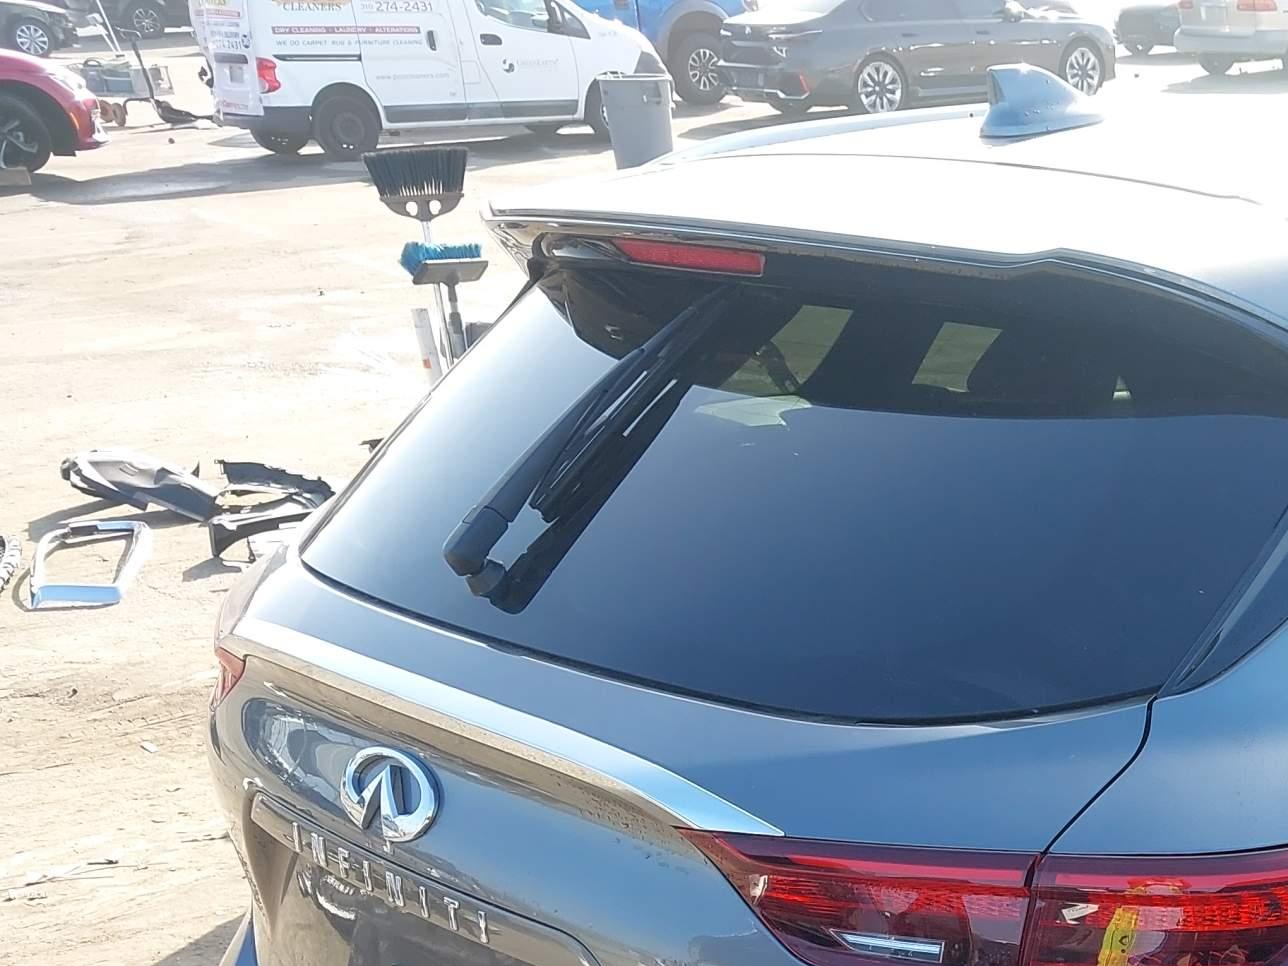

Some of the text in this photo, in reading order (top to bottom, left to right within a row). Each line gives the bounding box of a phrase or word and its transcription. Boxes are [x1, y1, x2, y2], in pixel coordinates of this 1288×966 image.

[283, 1, 342, 12] CLEANERS
[375, 1, 433, 12] 274-2431
[292, 821, 489, 944] INFINITI
